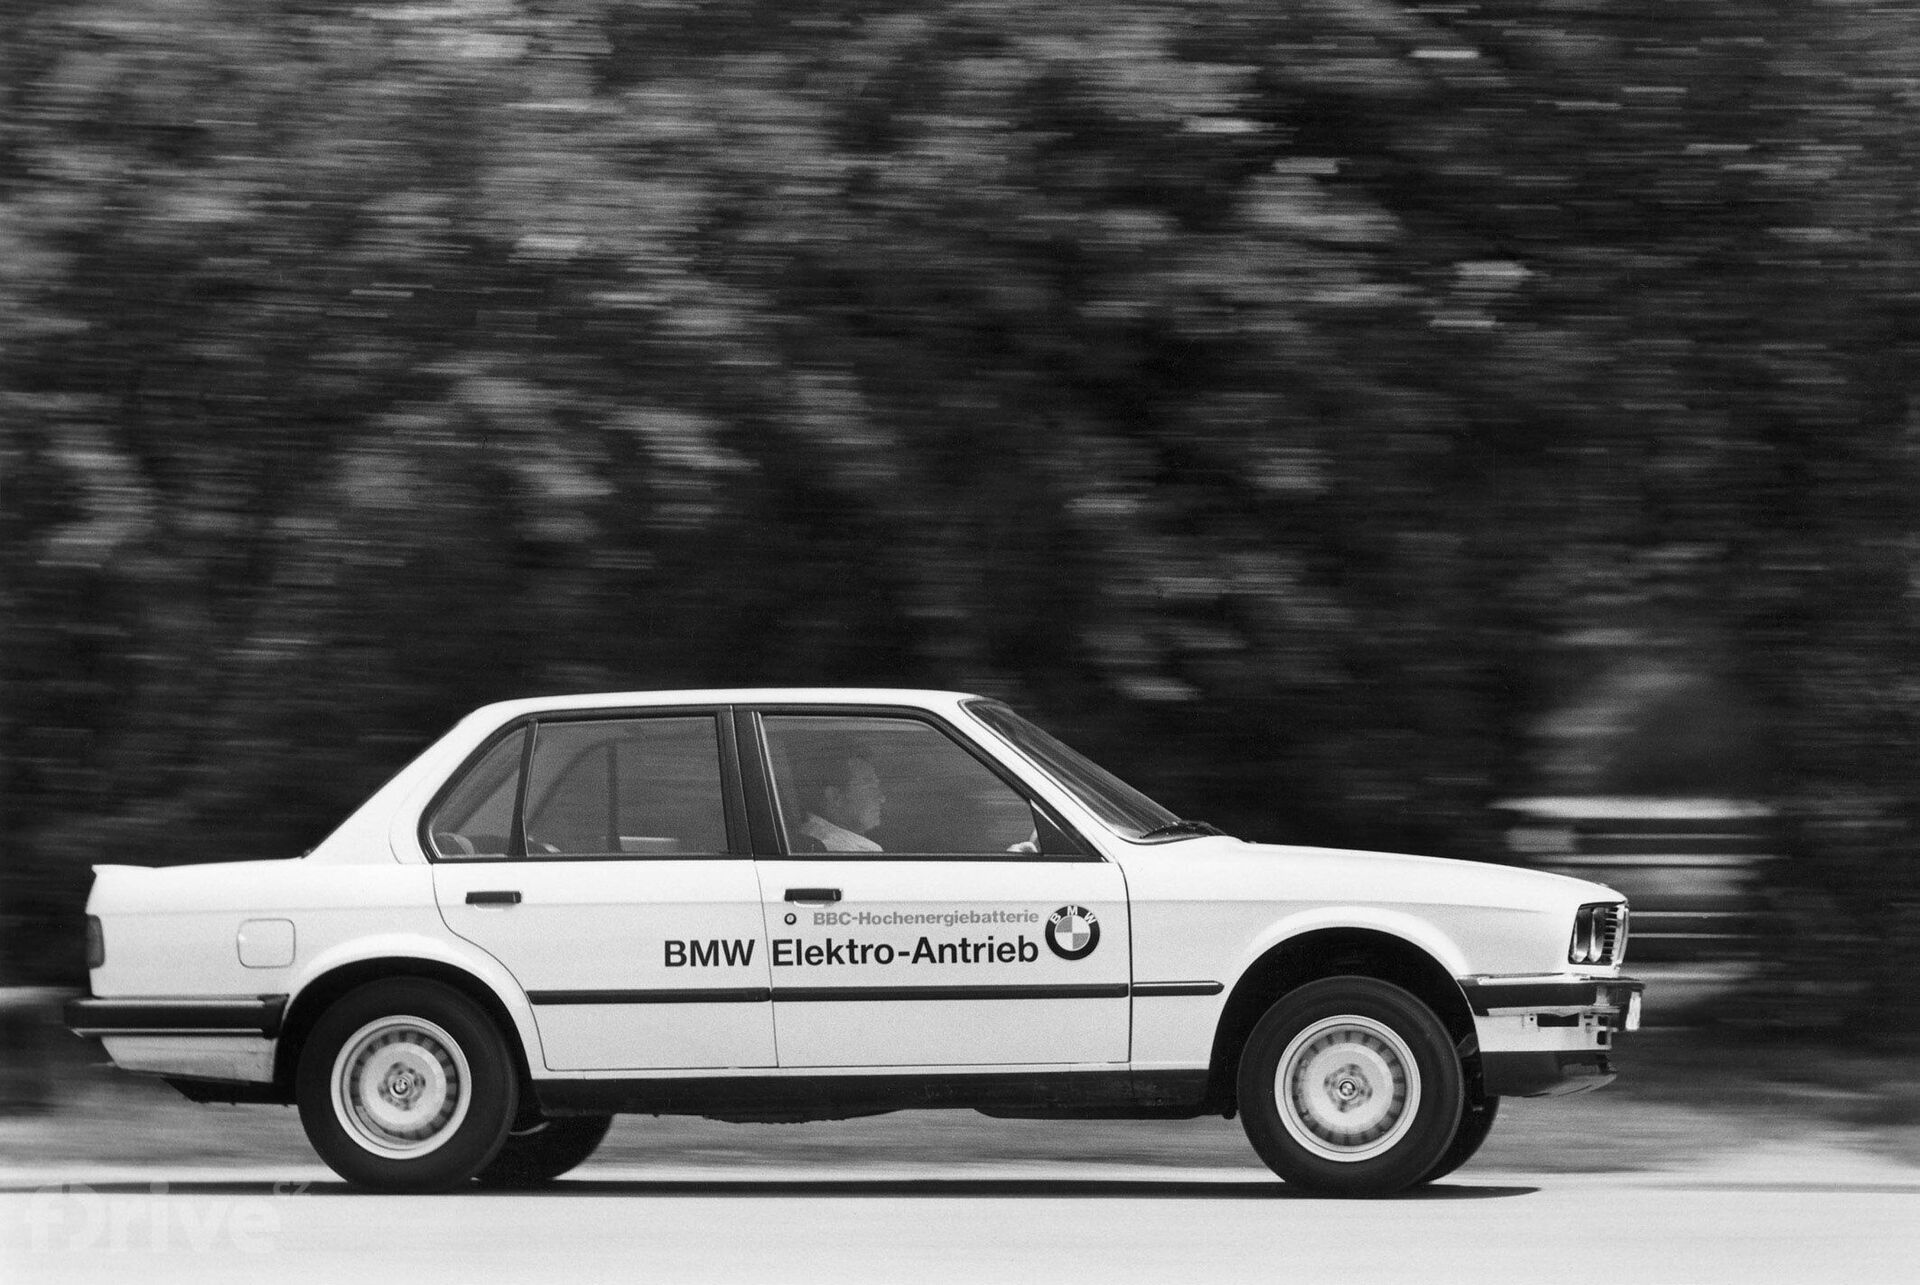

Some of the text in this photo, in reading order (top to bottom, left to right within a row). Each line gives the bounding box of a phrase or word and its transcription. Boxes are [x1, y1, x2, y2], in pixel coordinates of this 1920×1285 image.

[813, 910, 1040, 927] BBC-Hochenergiebatterie
[1049, 905, 1096, 924] BMW
[664, 935, 1039, 967] BMW Elektro-Antrieb
